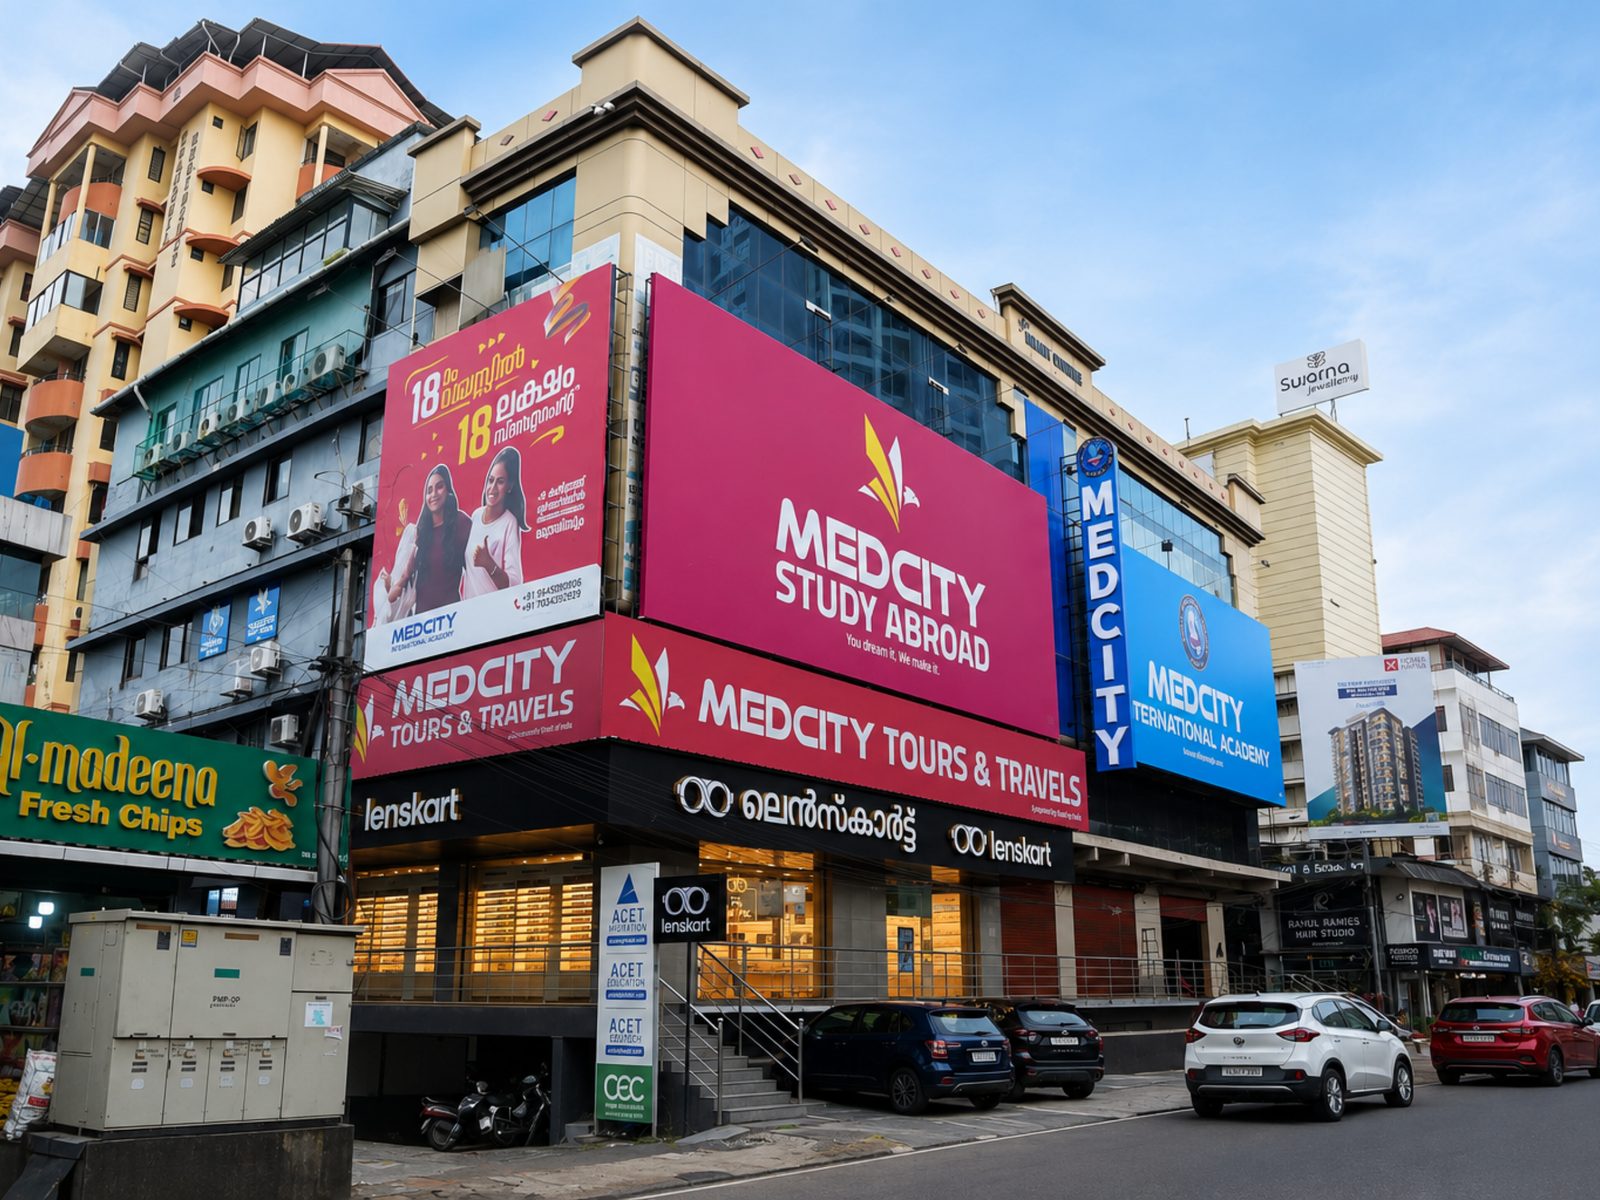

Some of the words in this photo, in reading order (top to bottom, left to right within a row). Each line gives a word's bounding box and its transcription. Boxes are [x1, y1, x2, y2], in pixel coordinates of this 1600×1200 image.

[412, 372, 440, 424] 18
[458, 405, 492, 465] 18
[775, 496, 986, 629] MEDCITY
[391, 612, 458, 645] MEDCITY
[776, 560, 877, 632] STUDY
[886, 603, 990, 672] ABROAD
[1081, 480, 1129, 766] MEDCITY
[846, 633, 862, 648] You
[863, 638, 888, 658] dream
[898, 651, 910, 666] We
[912, 658, 931, 674] make
[391, 639, 577, 718] MEDCITY
[1149, 660, 1244, 733] MEDCITY
[391, 714, 453, 748] TOURS
[458, 710, 472, 735] &
[479, 689, 574, 731] TRAVELS
[698, 677, 875, 760] MEDCITY
[883, 726, 968, 782] TOURS
[974, 751, 991, 787] &
[995, 755, 1082, 808] TRAVELS
[1221, 725, 1270, 768] ACADEMY
[18, 790, 109, 825] Fresh
[119, 804, 203, 840] Chips
[364, 788, 460, 831] lenskart
[989, 830, 1053, 868] lenskart
[612, 908, 645, 925] ACET
[661, 917, 711, 934] lenskart
[1320, 928, 1356, 938] STUDIO
[611, 962, 644, 978] ACET
[609, 1018, 642, 1034] ACET
